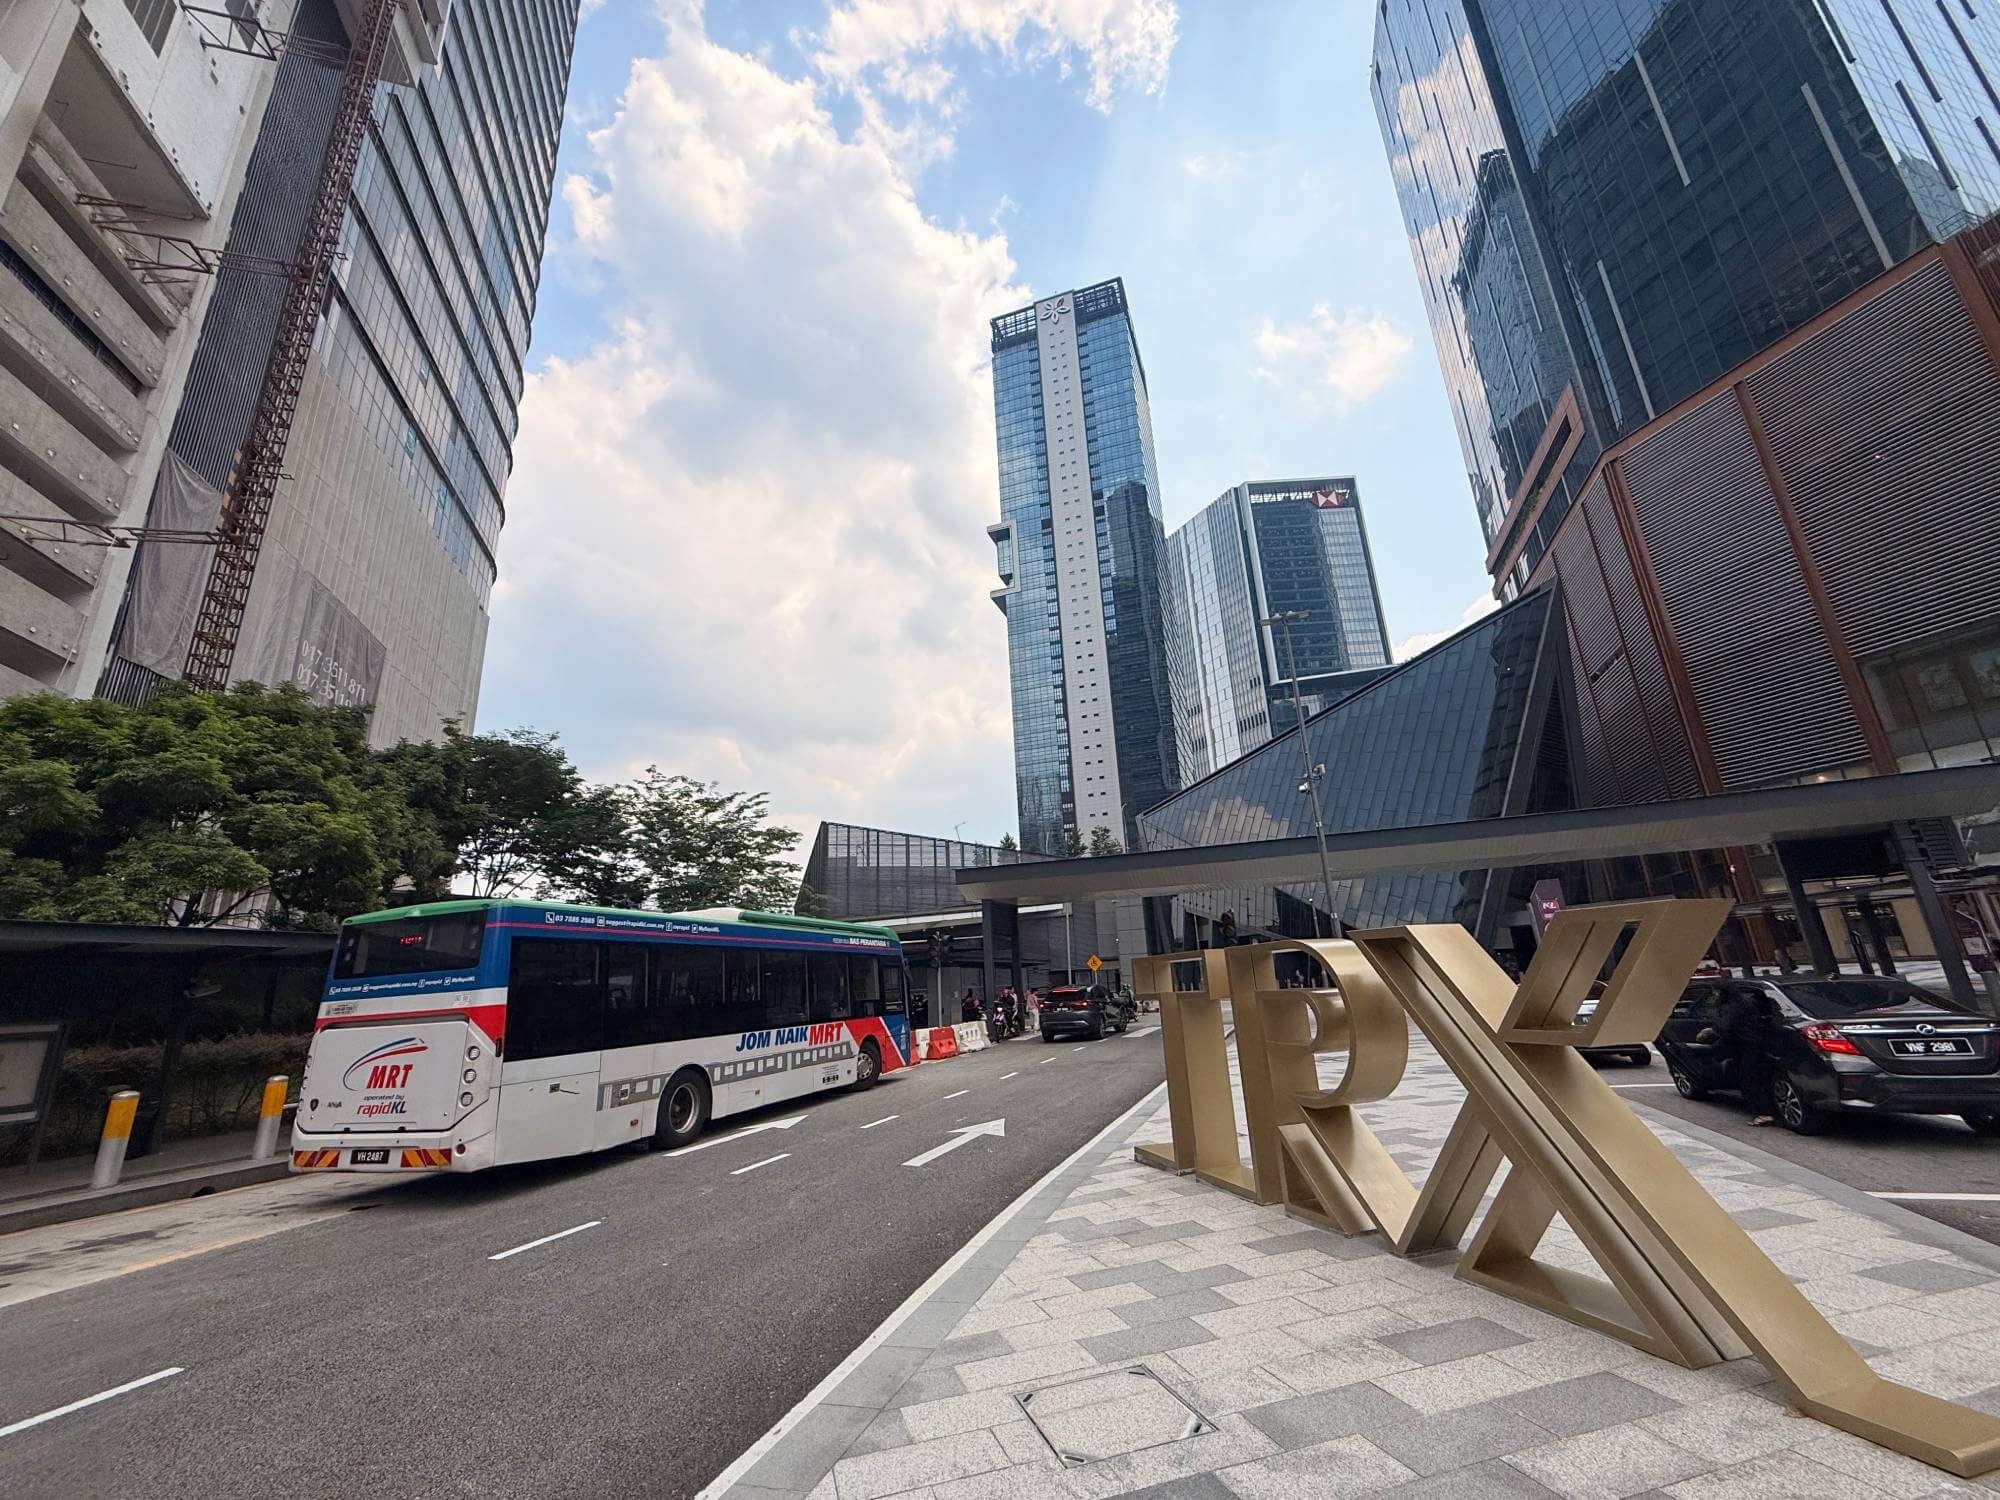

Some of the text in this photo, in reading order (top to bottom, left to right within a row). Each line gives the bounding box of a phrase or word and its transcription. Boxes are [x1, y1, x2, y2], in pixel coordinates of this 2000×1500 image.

[736, 1022, 844, 1053] JOM NAIK MRT
[366, 1064, 414, 1089] MRT
[357, 1101, 408, 1118] rapidKL
[357, 1151, 367, 1161] VH
[1132, 897, 1999, 1478] TRX
